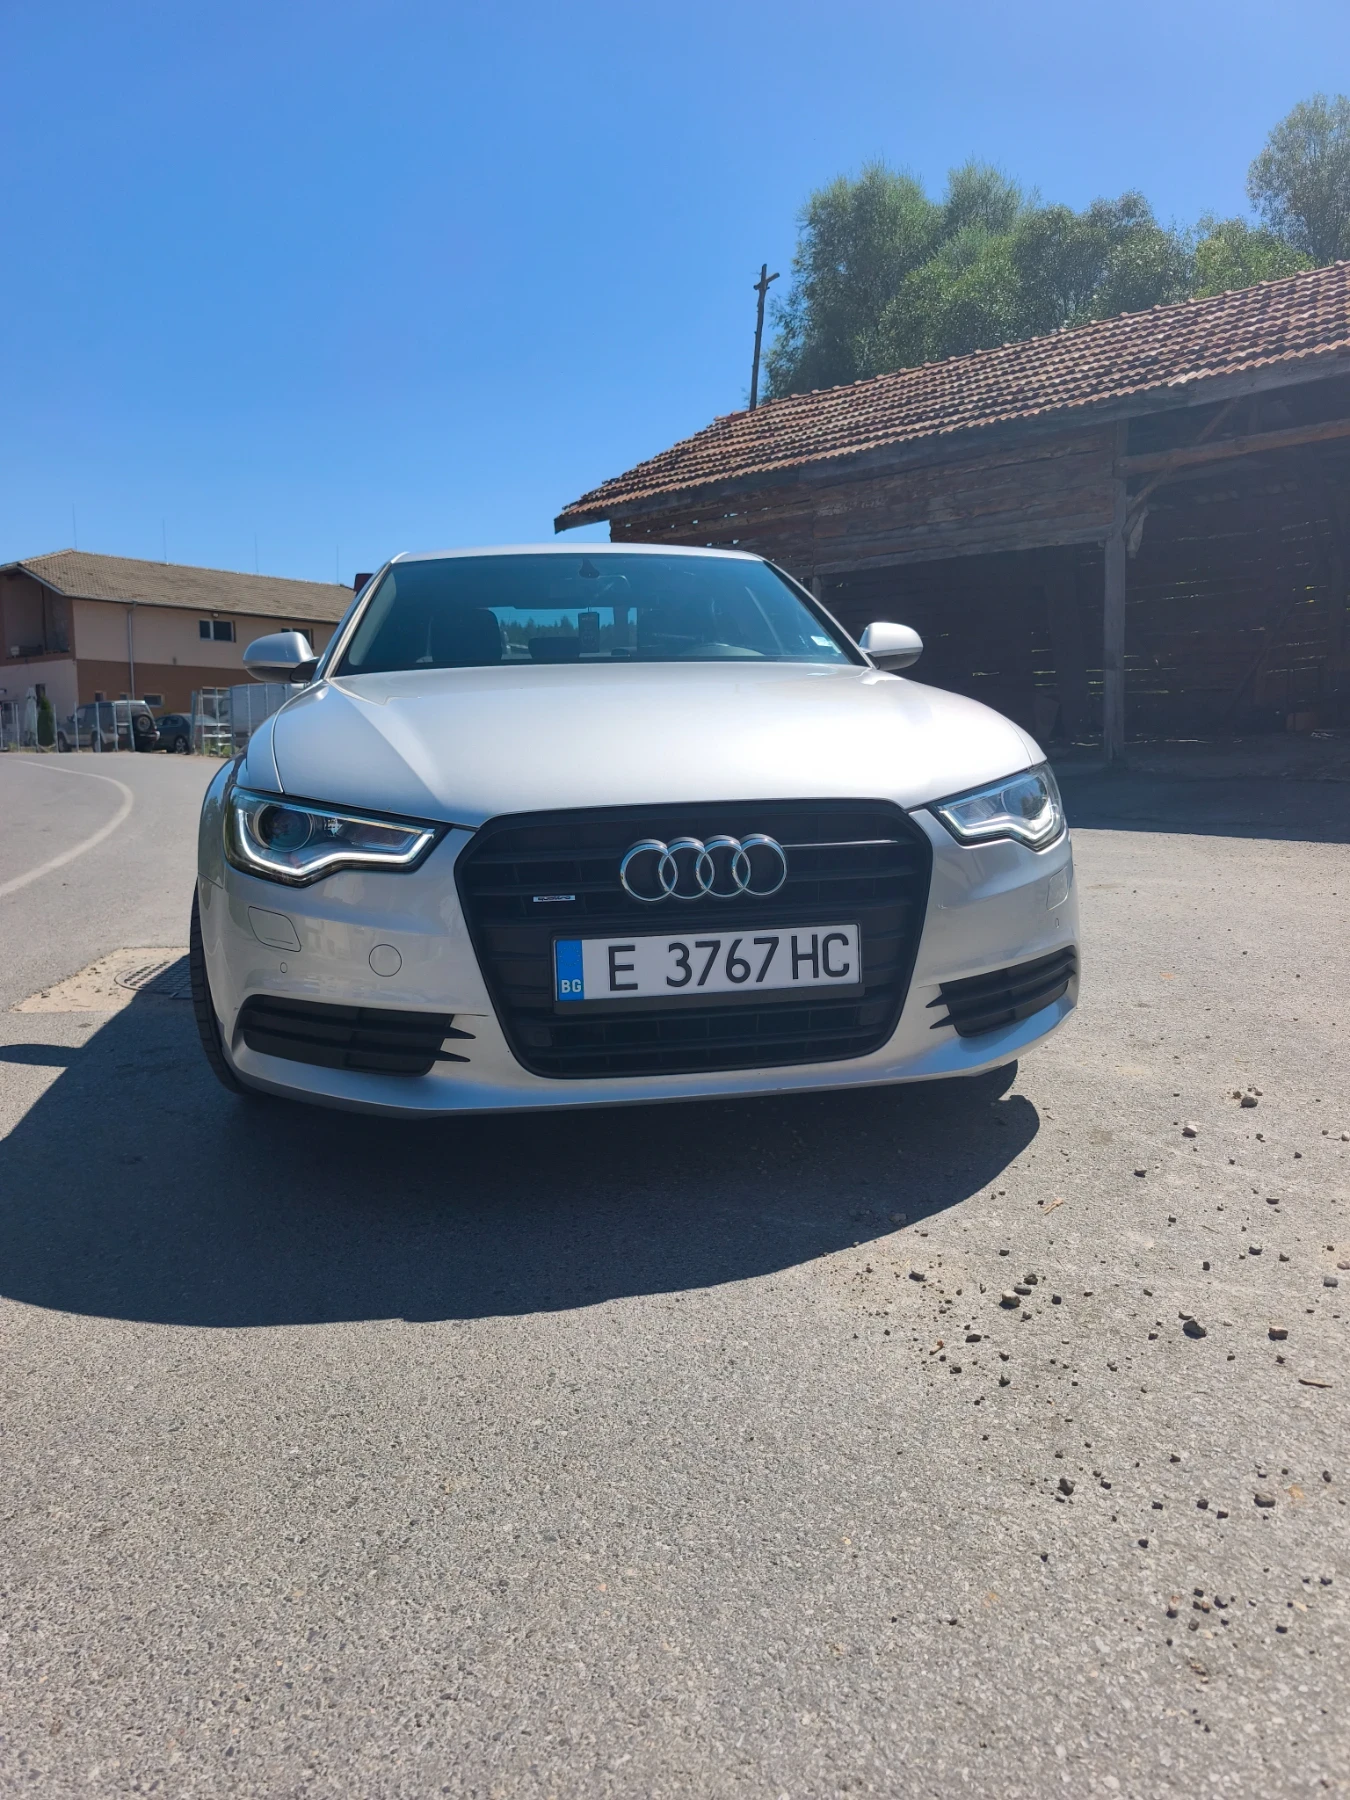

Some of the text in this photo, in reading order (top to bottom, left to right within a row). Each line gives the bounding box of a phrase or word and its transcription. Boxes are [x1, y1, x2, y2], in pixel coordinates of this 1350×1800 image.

[608, 933, 850, 992] E 3767 HC
[561, 979, 582, 993] BG
